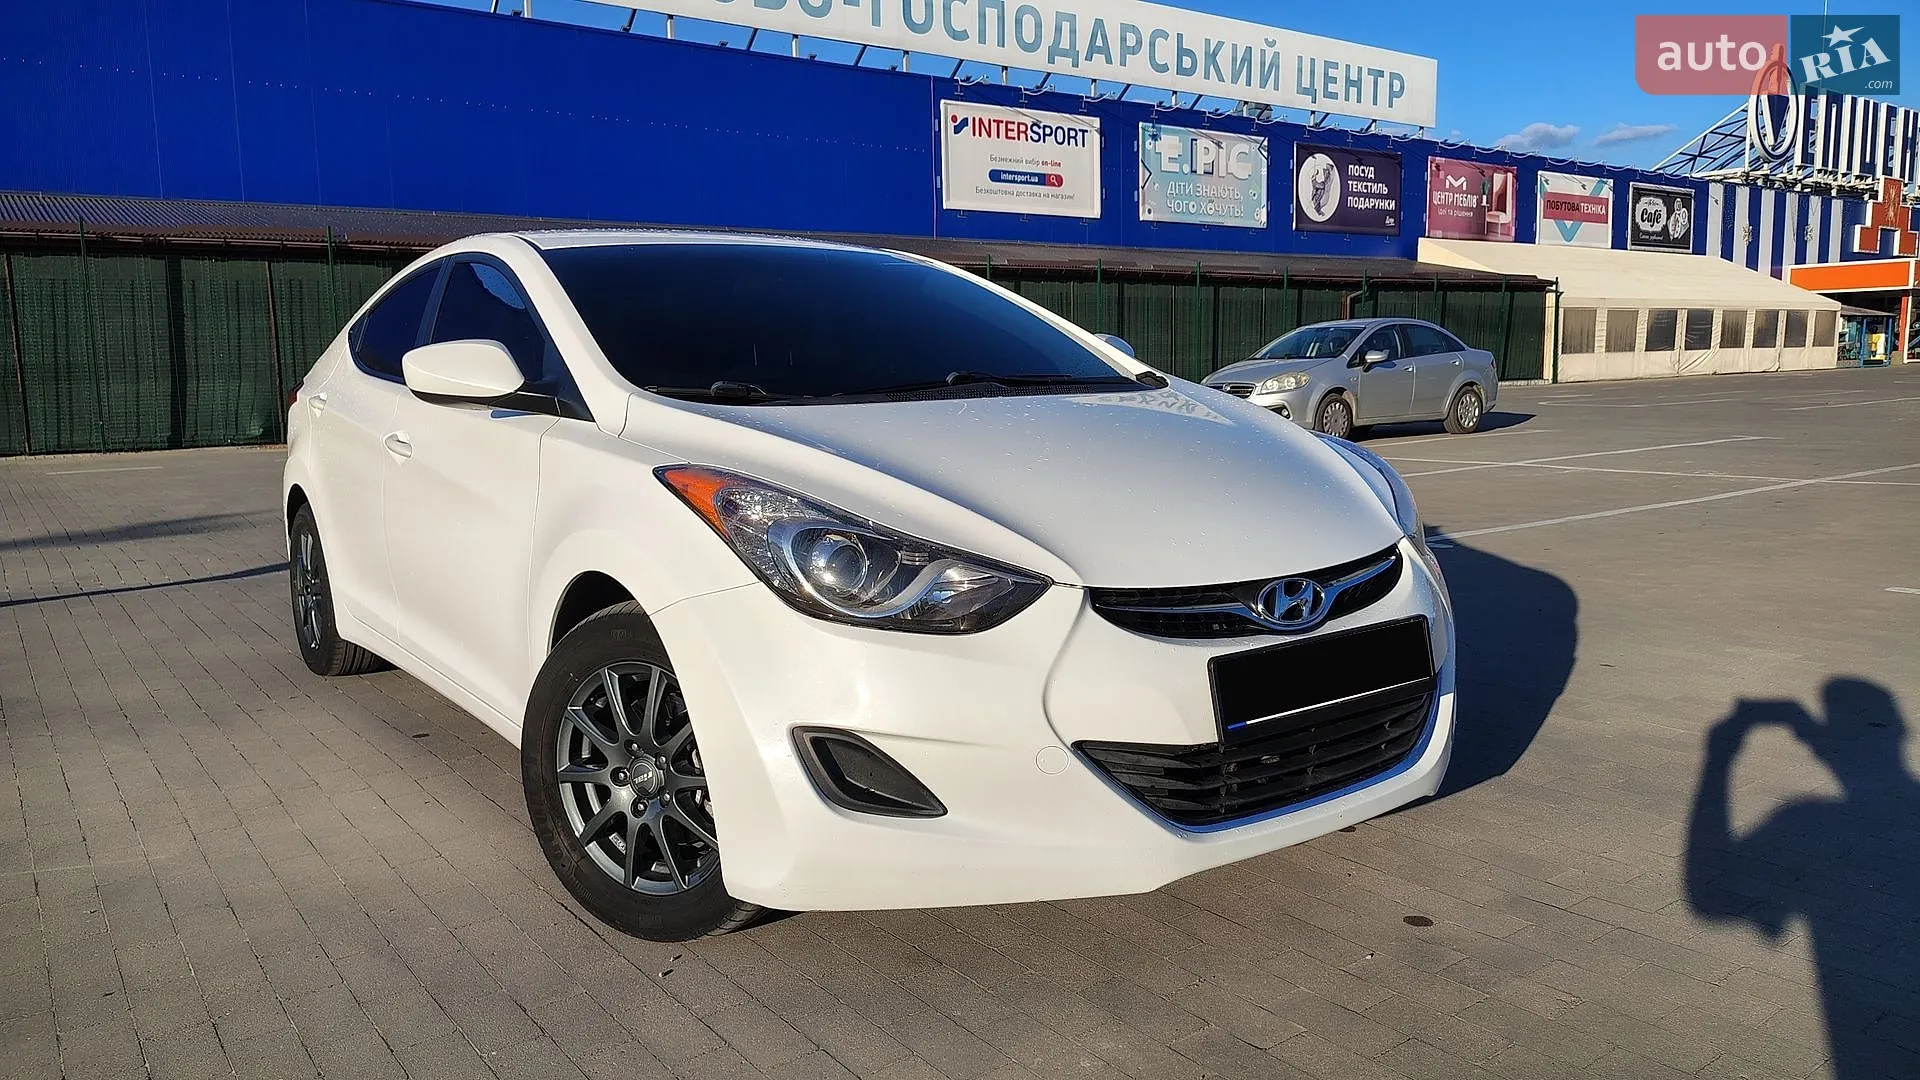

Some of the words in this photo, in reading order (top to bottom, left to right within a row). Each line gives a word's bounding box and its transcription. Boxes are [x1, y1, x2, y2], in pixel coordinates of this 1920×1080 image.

[1296, 55, 1406, 109] ЦЕНТР
[972, 116, 1088, 148] INTERSPORT
[1041, 160, 1062, 168] on-line
[1348, 164, 1375, 180] ПОСУД
[1000, 172, 1039, 183] intersport.ua
[975, 186, 1014, 197] Безкоштовна
[1015, 189, 1042, 199] доставка
[1043, 191, 1050, 199] на
[1167, 181, 1193, 197] ДІТИ
[1195, 184, 1244, 201] ЗНАЮТЬ,
[1347, 180, 1388, 195] ТЕКСТИЛЬ
[1347, 196, 1396, 211] ПОДАРУНКИ
[1432, 190, 1453, 206] ЦЕНТР
[1453, 192, 1477, 208] МЕБЛІВ
[1166, 199, 1197, 214] ЧОГО
[1200, 201, 1244, 218] ХОЧУТЬ!
[1546, 199, 1580, 213] ПОБУТОВА
[1580, 202, 1607, 216] ТЕХНІКА
